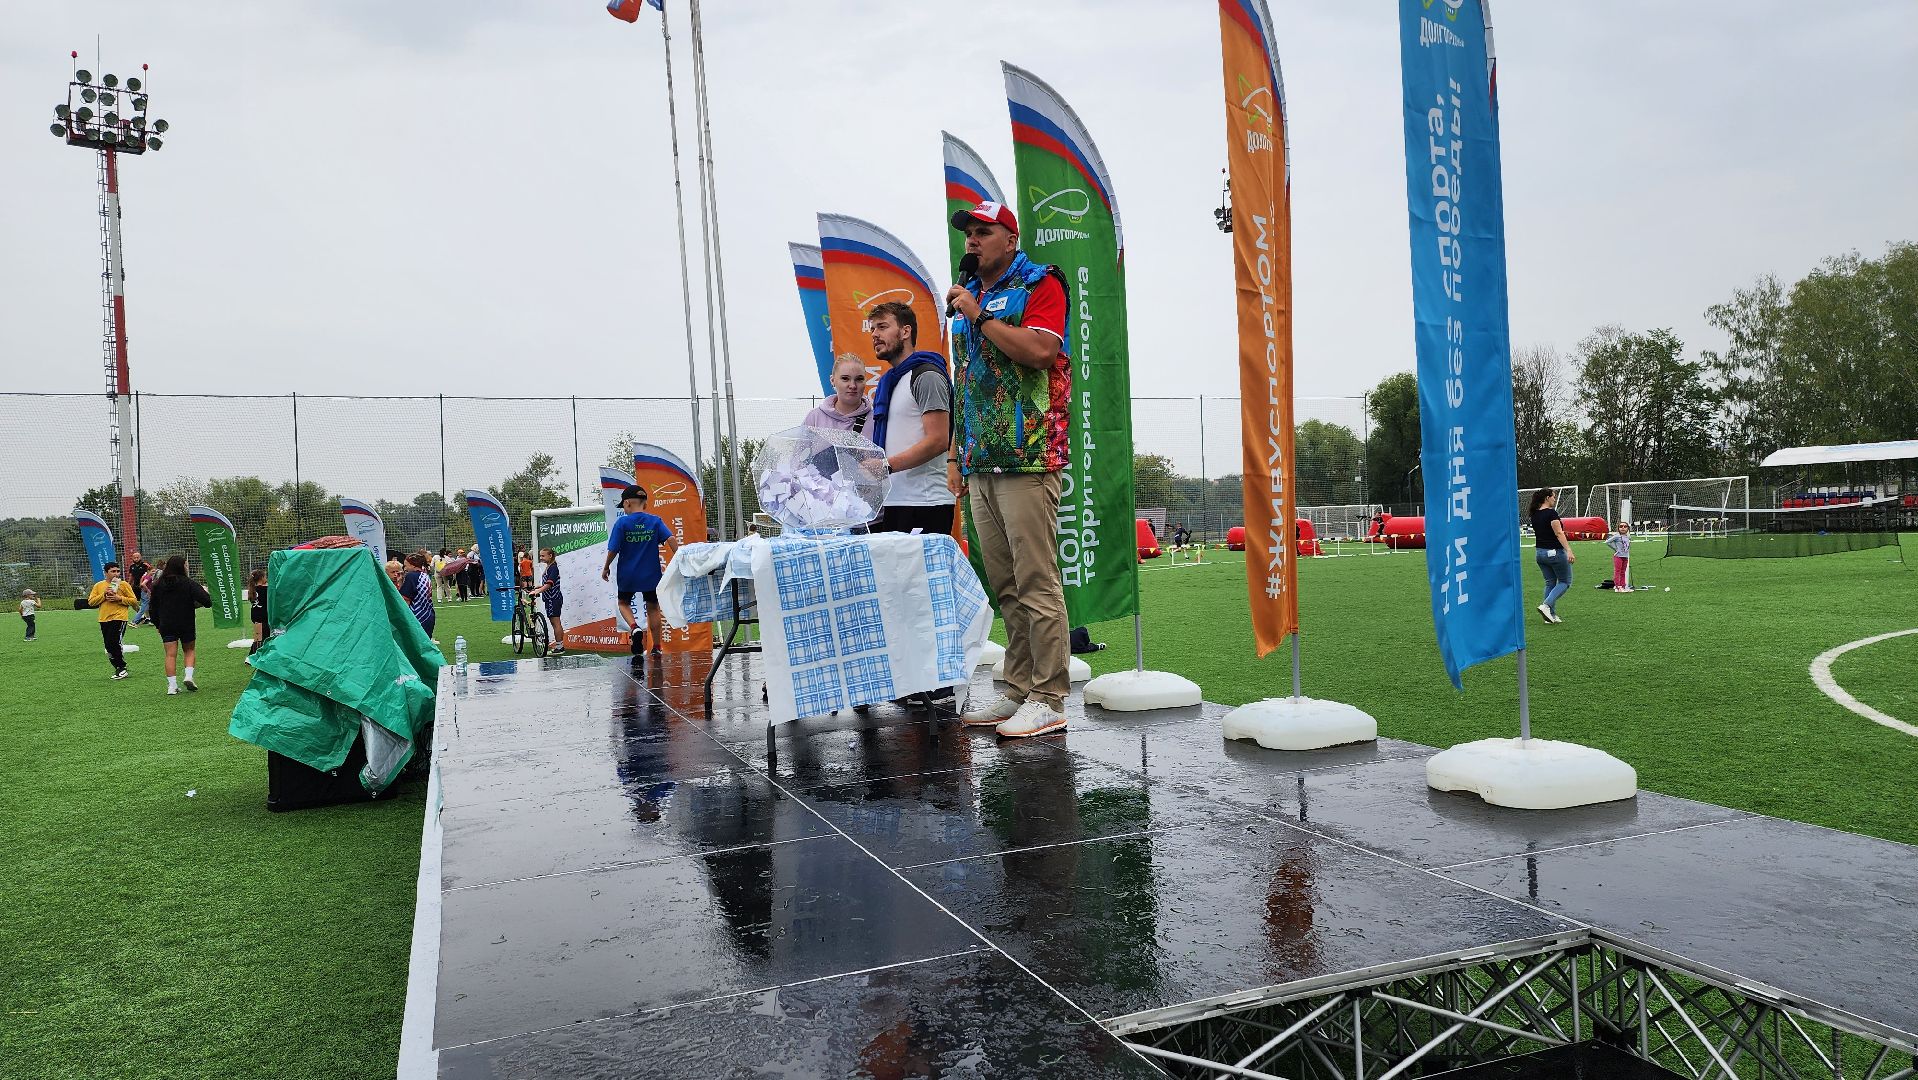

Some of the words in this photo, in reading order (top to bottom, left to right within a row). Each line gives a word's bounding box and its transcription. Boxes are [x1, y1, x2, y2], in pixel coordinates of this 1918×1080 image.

[1449, 77, 1463, 302] победы!
[1077, 266, 1091, 381] спорта
[1080, 391, 1101, 585] территория
[210, 552, 232, 619] ДОЛГОПРУДНЫЙ
